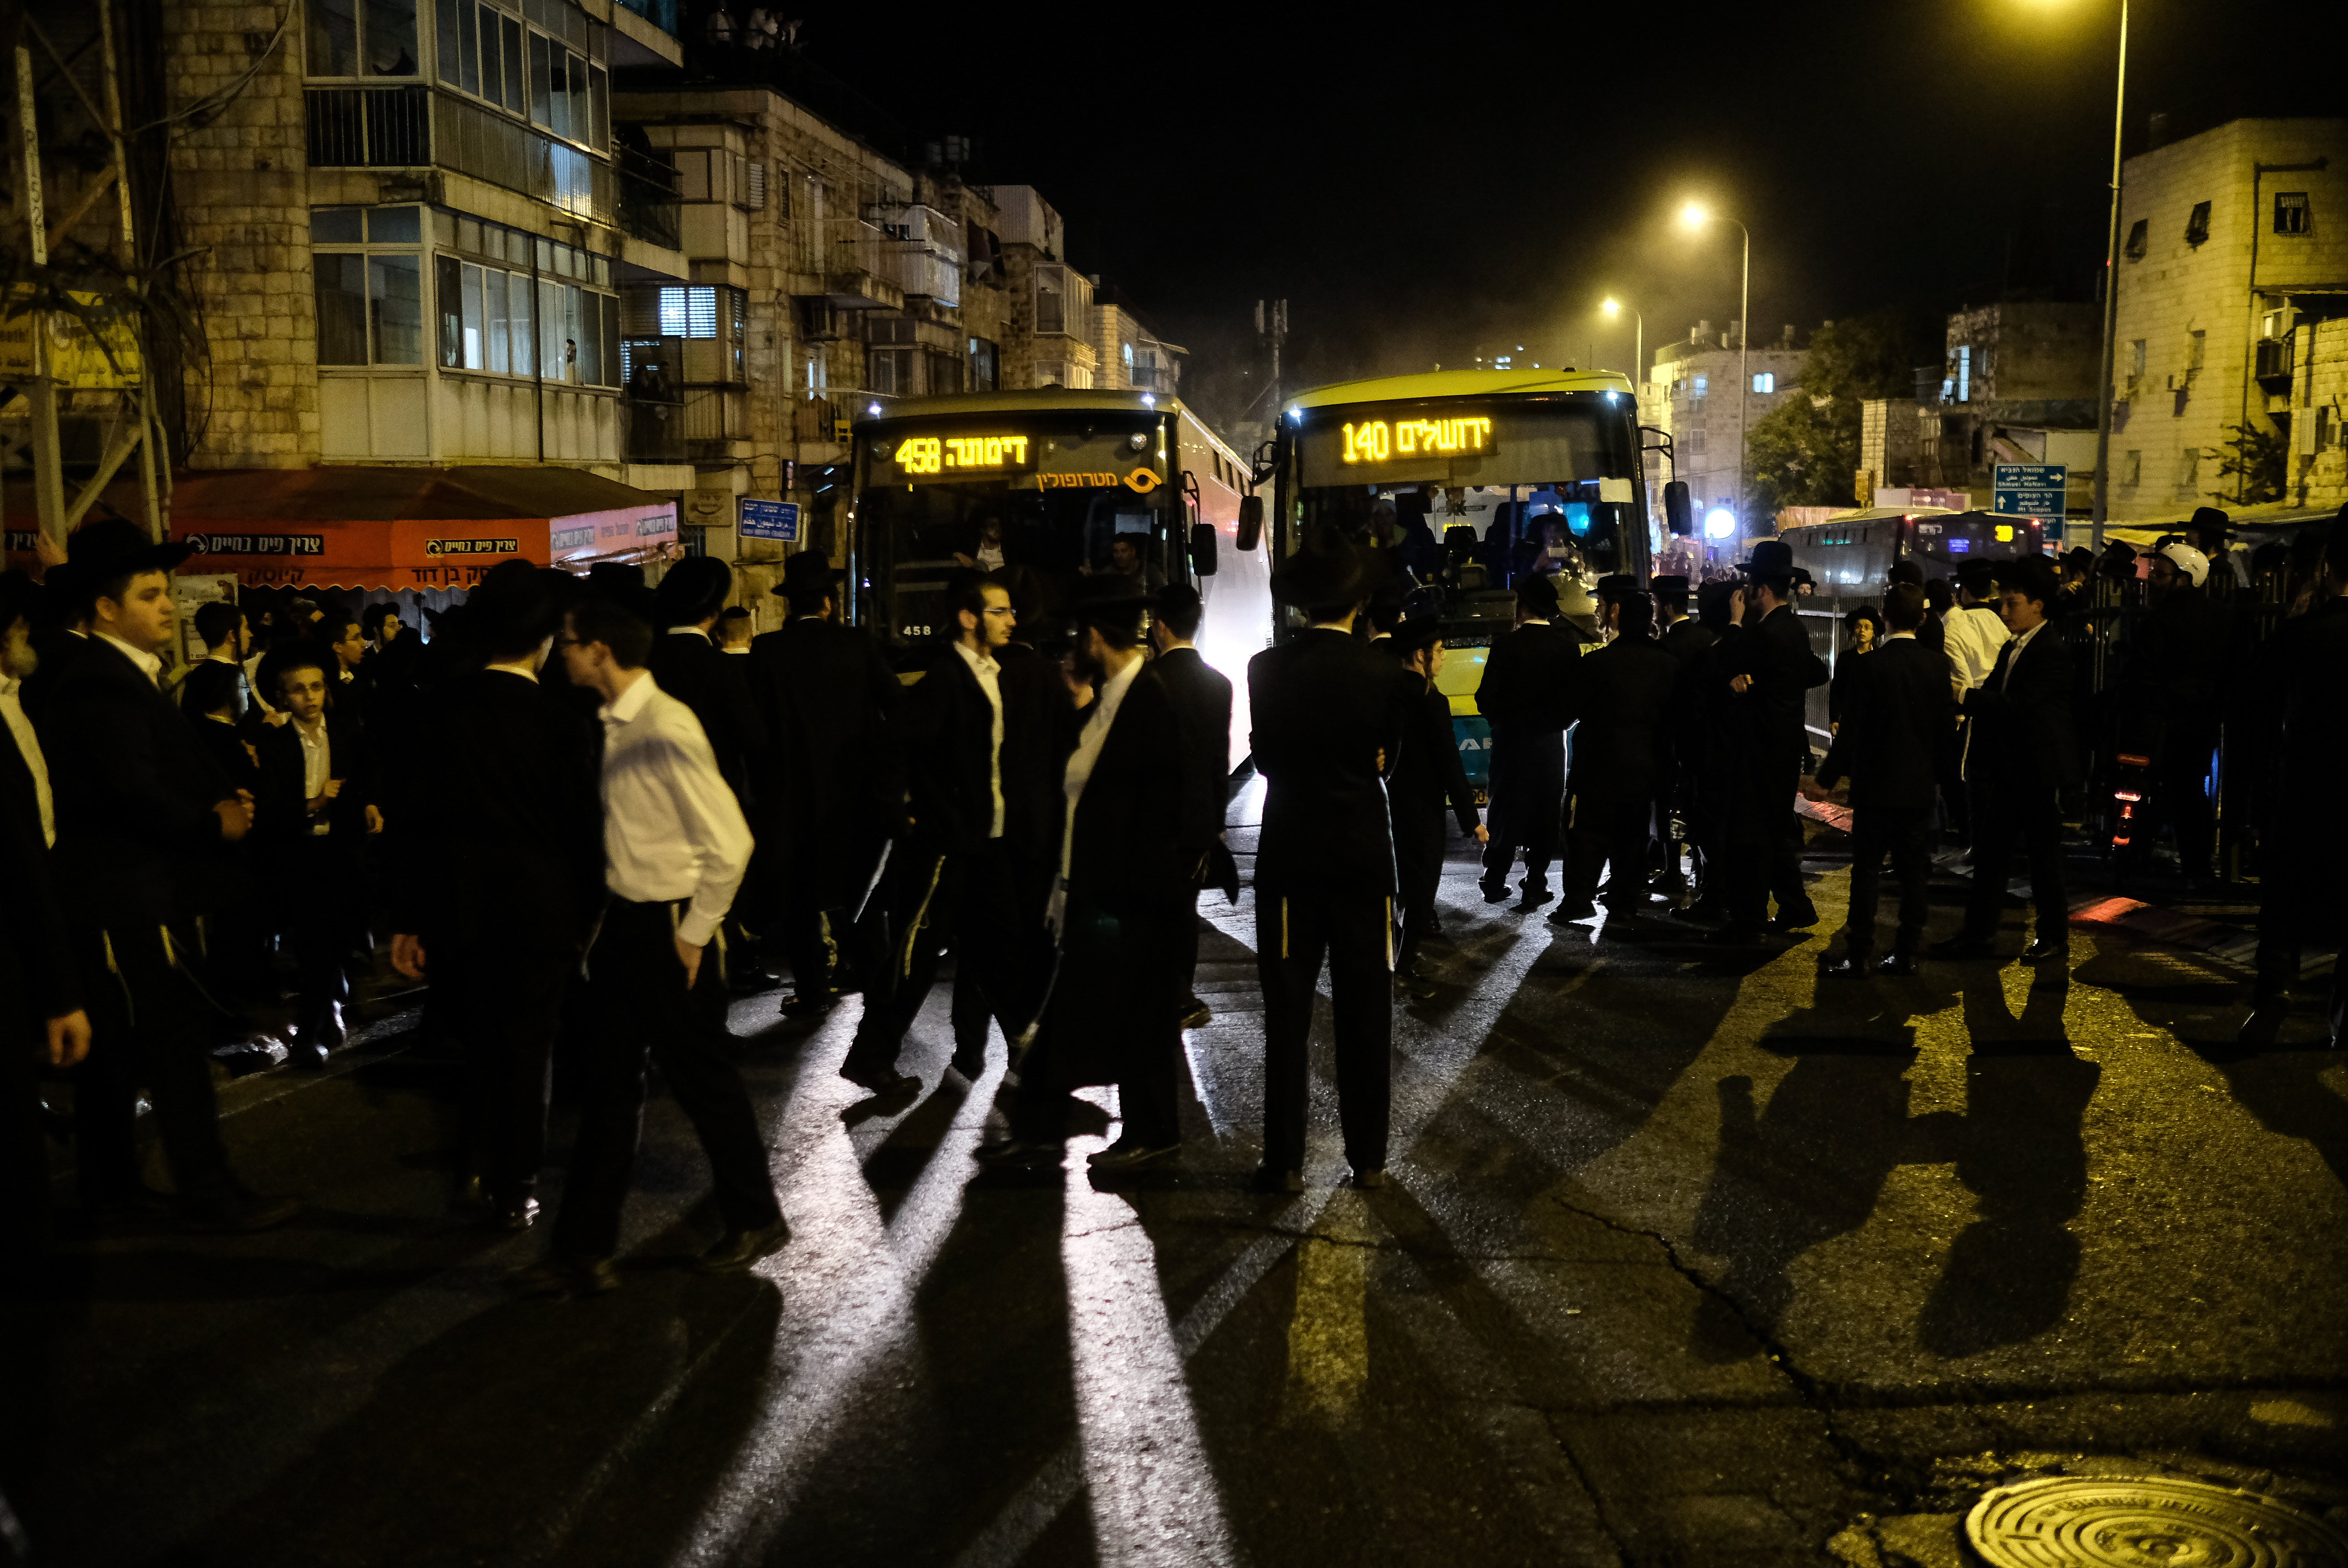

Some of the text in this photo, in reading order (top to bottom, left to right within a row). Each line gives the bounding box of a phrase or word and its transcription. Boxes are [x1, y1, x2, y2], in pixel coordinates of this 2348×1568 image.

[1342, 417, 1490, 461] 140 ירושלים
[895, 436, 1028, 473] 458 דימונה
[1036, 472, 1119, 493] מטרופולין
[212, 537, 321, 555] צריך פיס בחיים
[248, 569, 305, 585] קיוסק
[411, 569, 439, 582] דוד
[444, 568, 461, 586] בן
[903, 625, 931, 636] 458
